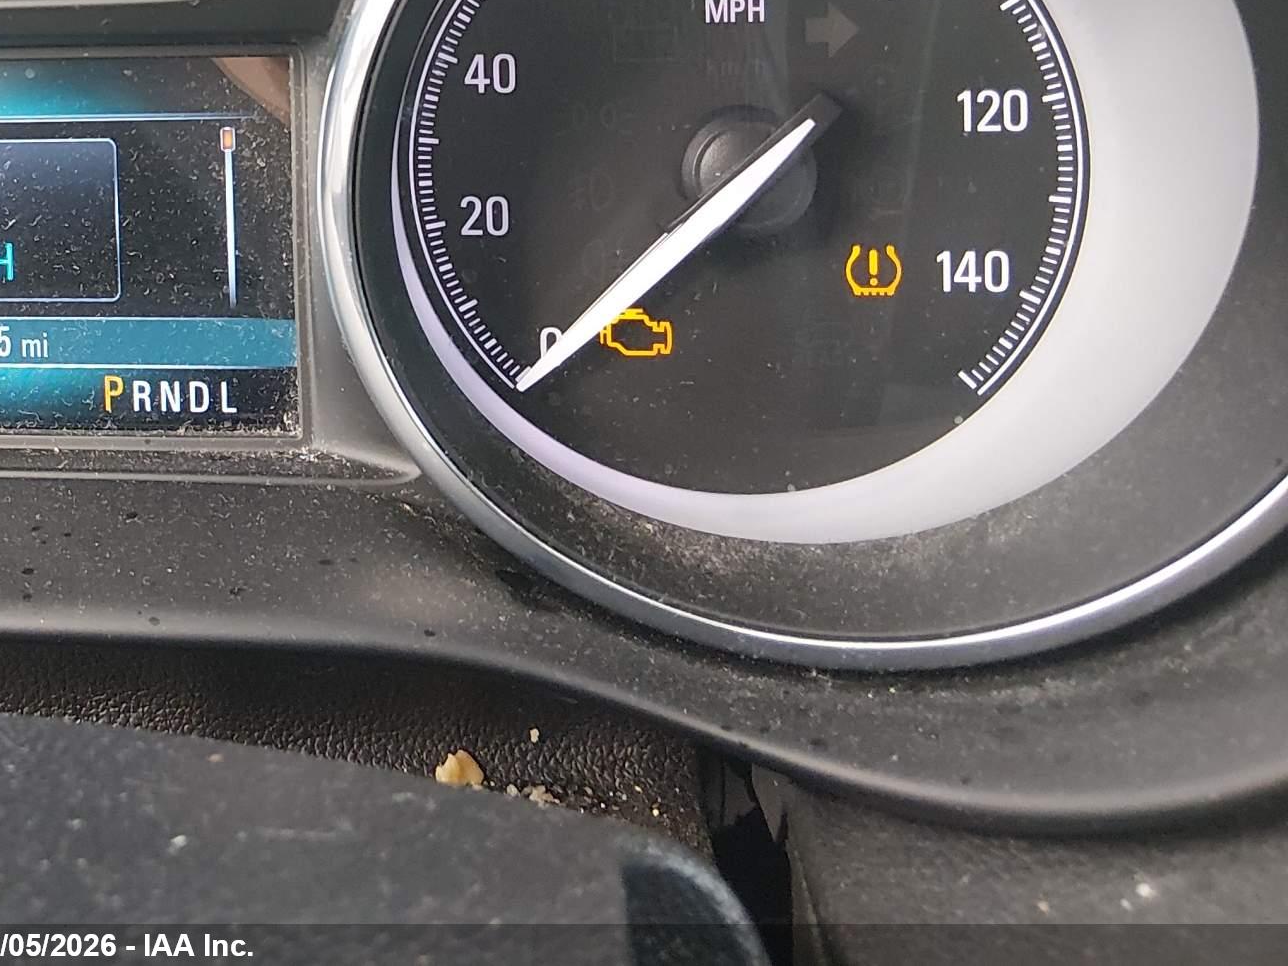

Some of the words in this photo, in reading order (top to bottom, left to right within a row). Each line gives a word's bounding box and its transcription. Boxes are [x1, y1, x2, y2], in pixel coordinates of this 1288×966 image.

[464, 53, 516, 94] 40
[957, 89, 1029, 132] 120
[460, 195, 509, 236] 20
[936, 250, 1010, 293] 140
[21, 337, 48, 358] mi
